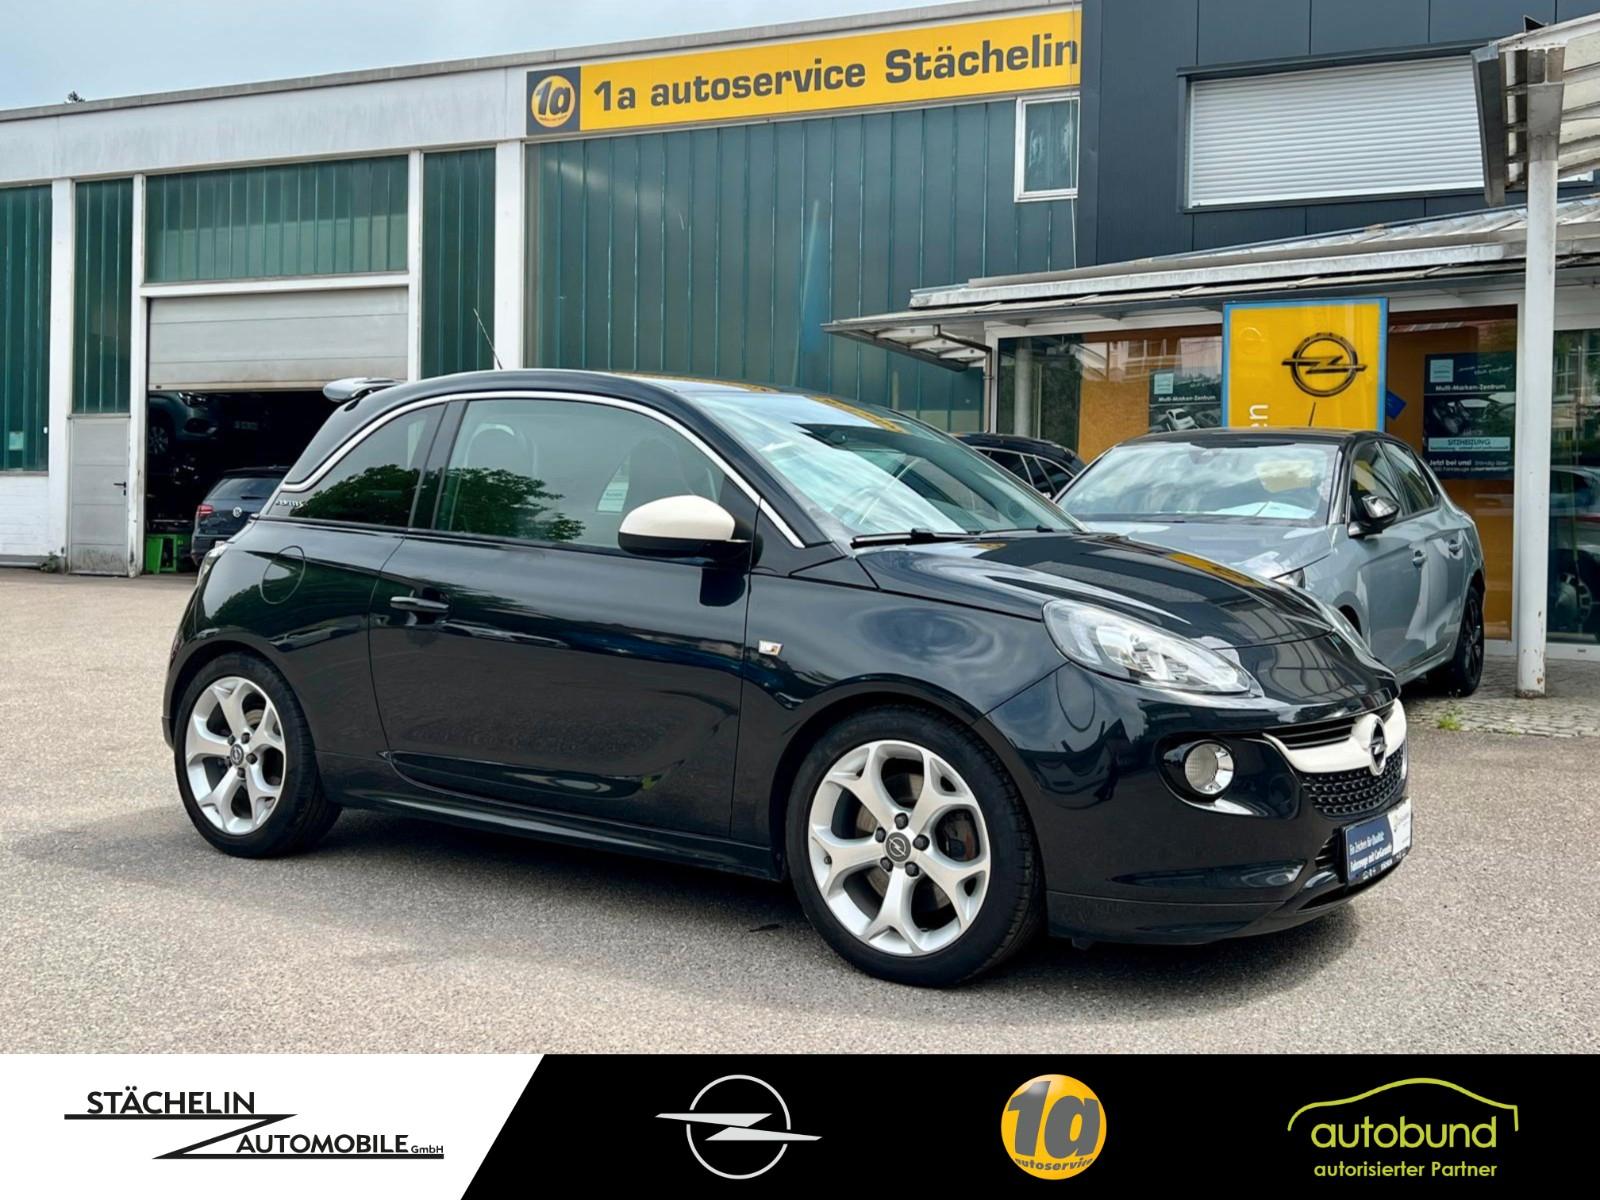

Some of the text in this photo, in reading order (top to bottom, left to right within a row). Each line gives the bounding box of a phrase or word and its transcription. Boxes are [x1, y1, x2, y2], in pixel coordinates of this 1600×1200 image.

[535, 81, 570, 116] 1a
[594, 33, 1078, 111] 1a autoservice Stächelin
